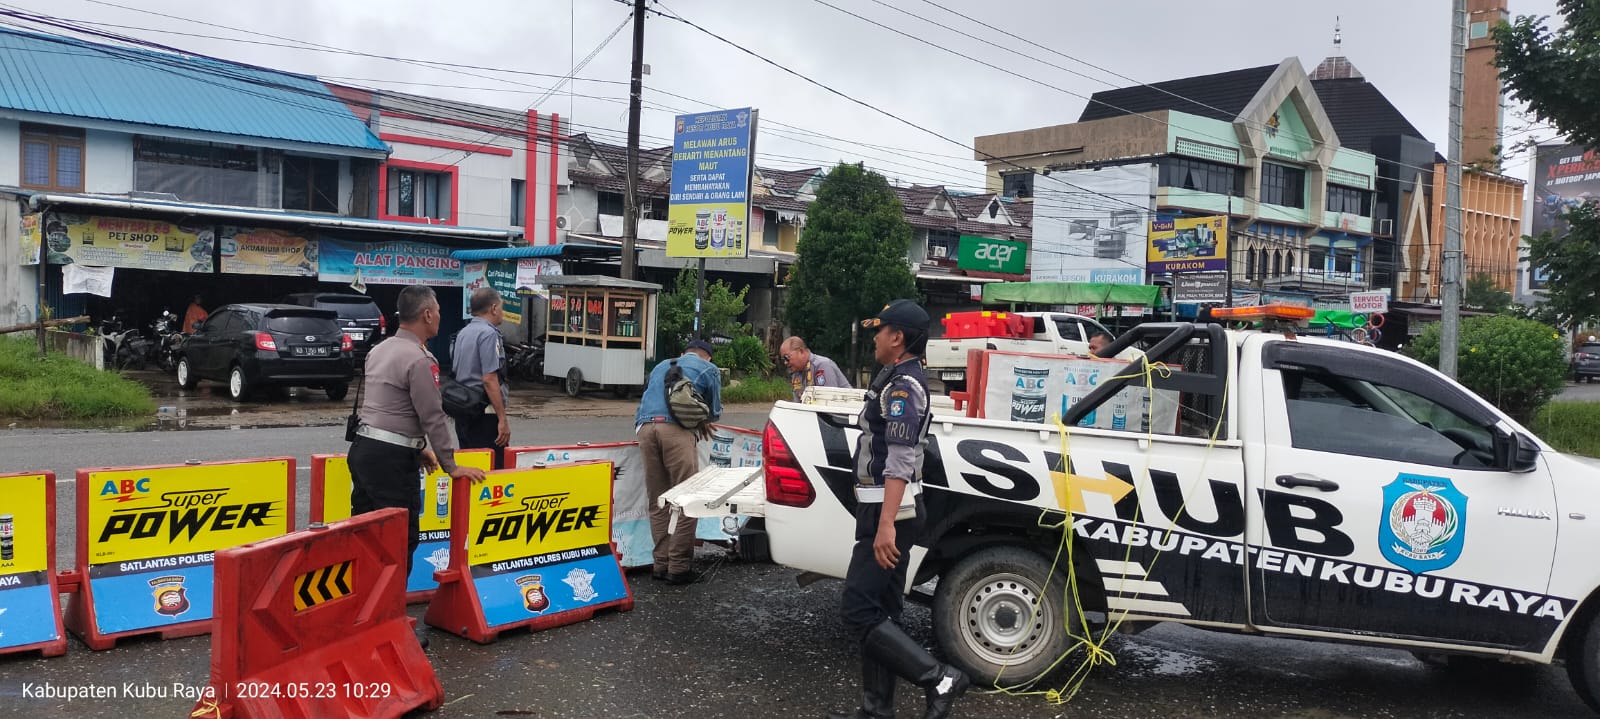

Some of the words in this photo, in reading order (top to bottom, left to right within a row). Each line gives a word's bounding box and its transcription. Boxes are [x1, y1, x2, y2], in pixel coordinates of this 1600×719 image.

[683, 139, 716, 149] MELAWAN
[718, 137, 737, 147] ARUS
[674, 151, 702, 160] BERARTI
[704, 147, 746, 159] MENANTANG
[698, 161, 719, 171] MAUT
[690, 174, 707, 183] SERTA
[708, 173, 726, 181] DAPAT
[1555, 174, 1584, 184] MOTOGP
[711, 190, 731, 199] ORANG
[697, 219, 709, 227] ABC
[713, 213, 727, 223] ABC
[108, 231, 130, 241] PET
[131, 232, 159, 244] SHOP
[668, 227, 694, 235] POWER
[240, 244, 279, 256] AKUARIUM
[974, 242, 1018, 269] acer
[353, 253, 392, 267] ALAT
[395, 256, 461, 271] PANCING
[1094, 274, 1137, 284] KURAKOM
[1015, 377, 1046, 390] ABC
[1063, 373, 1098, 386] ABC
[1011, 402, 1045, 415] POWER
[713, 443, 730, 453] ABC
[742, 442, 763, 453] ABC
[100, 478, 150, 496] ABC
[479, 484, 515, 501] ABC
[160, 488, 230, 510] Super
[520, 497, 567, 513] Super
[98, 501, 283, 544] POWER
[476, 505, 607, 546] POWER
[428, 531, 451, 540] KUBU
[120, 556, 177, 573] SATLANTAS
[178, 552, 215, 565] POLRES
[492, 559, 534, 572] SATLANTAS
[534, 554, 562, 565] POLRES
[562, 551, 581, 560] KUBU
[581, 547, 598, 557] RAYA
[1072, 517, 1317, 578] KABUPATEN
[1319, 560, 1447, 599] KUBU
[1447, 583, 1565, 621] RAYA
